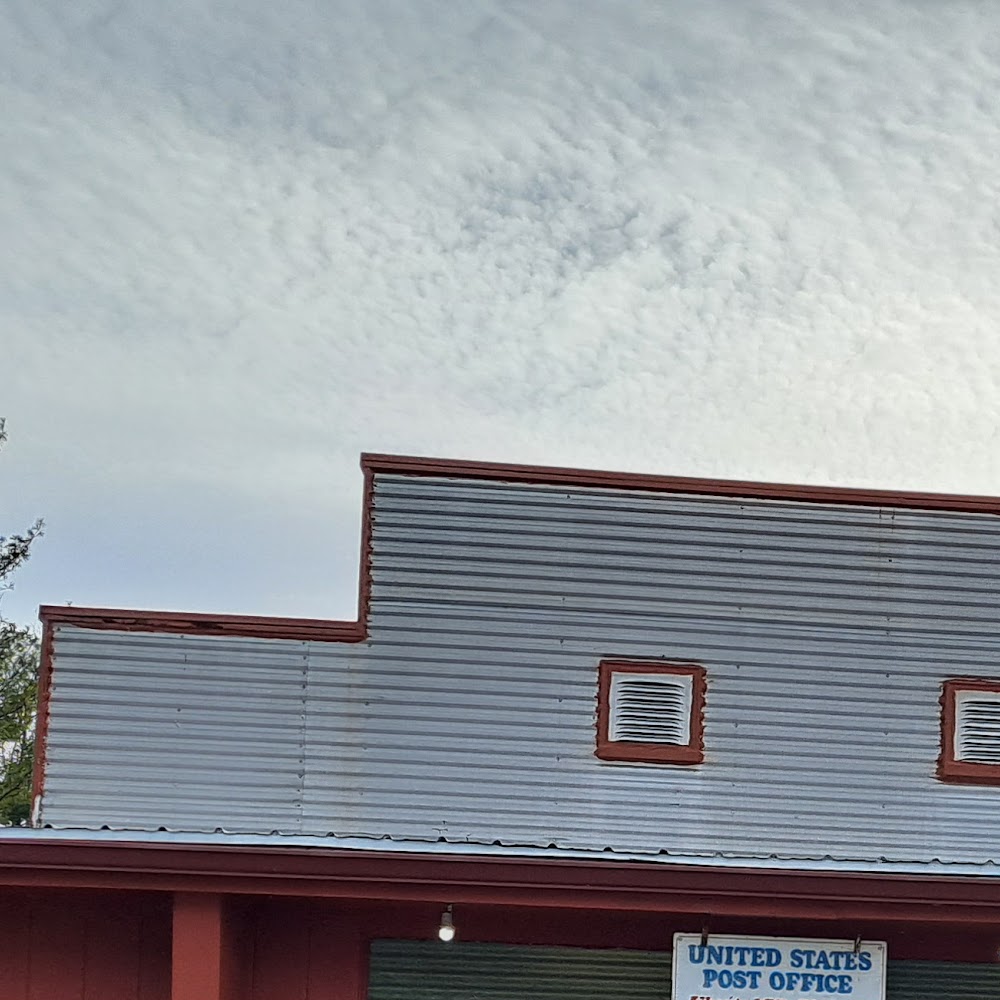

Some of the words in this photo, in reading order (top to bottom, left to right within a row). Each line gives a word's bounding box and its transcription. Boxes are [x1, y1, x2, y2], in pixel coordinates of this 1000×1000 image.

[688, 944, 782, 968] UNITED
[790, 949, 872, 971] STATES
[702, 969, 761, 989] POST
[769, 972, 853, 994] OFFICE
